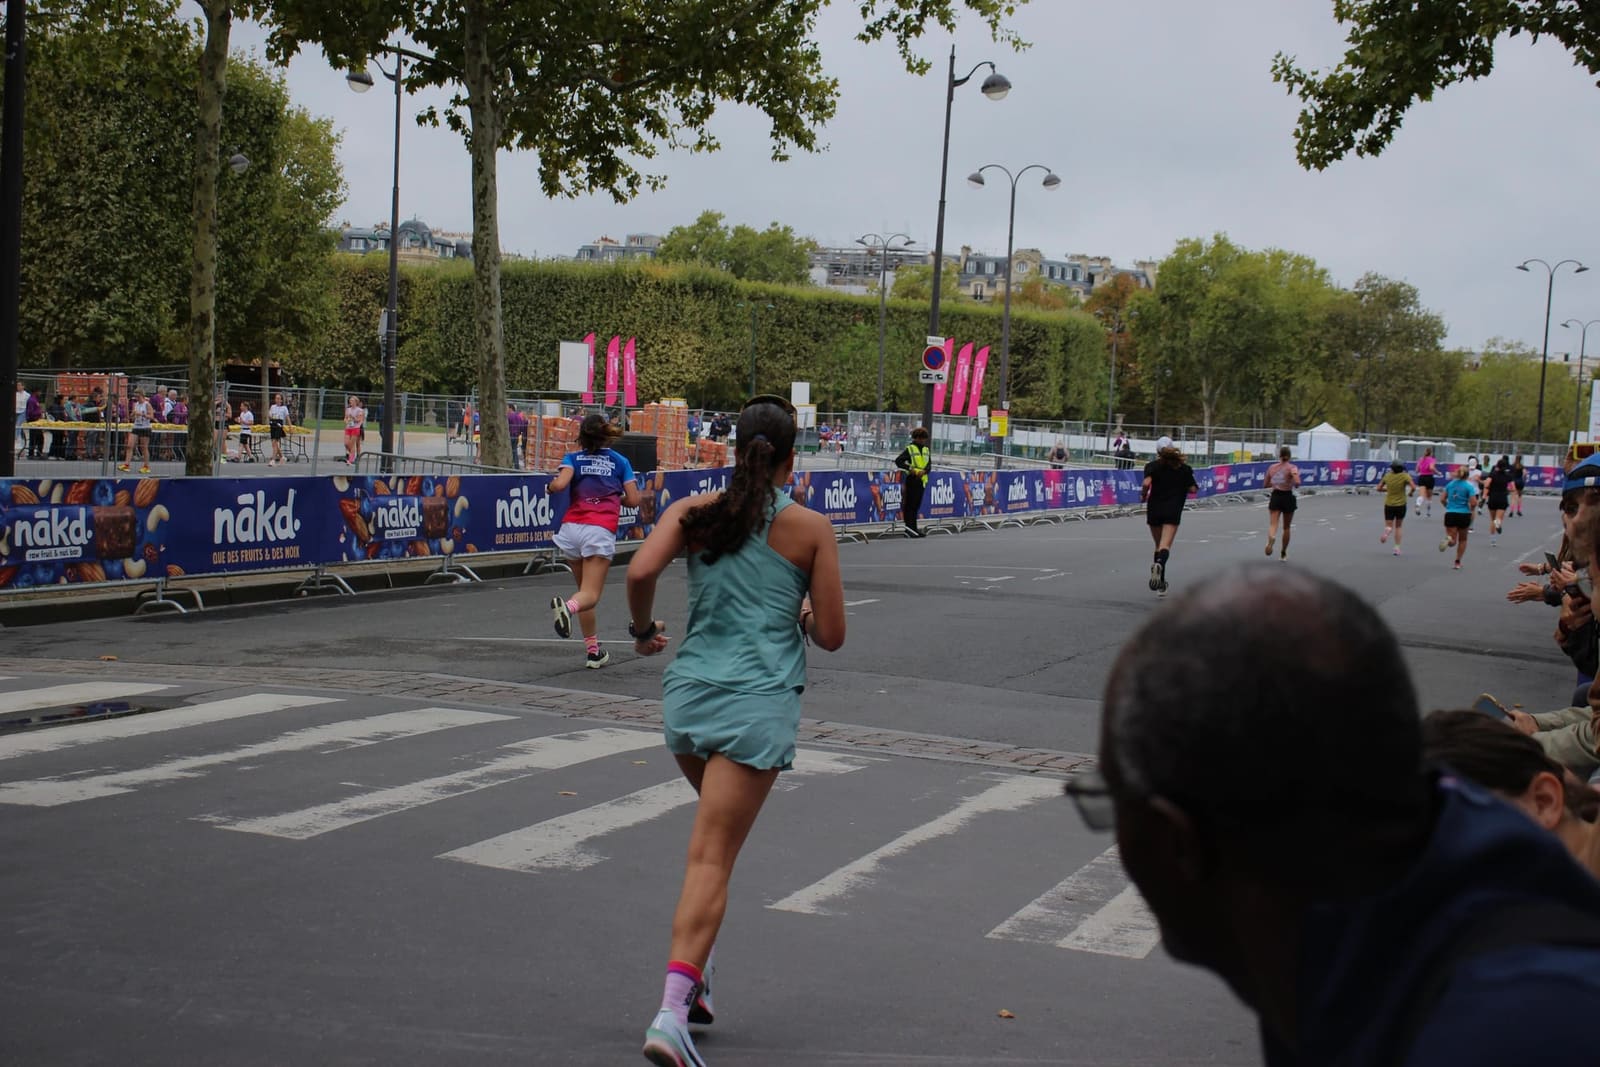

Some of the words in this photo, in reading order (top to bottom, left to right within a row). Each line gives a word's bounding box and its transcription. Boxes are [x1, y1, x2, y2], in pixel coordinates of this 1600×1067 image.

[582, 467, 611, 475] Energy
[212, 551, 226, 564] QUE
[227, 550, 239, 563] DES
[240, 548, 263, 562] FRUITS
[264, 547, 271, 560] &
[271, 546, 283, 559] DES
[285, 545, 300, 558] NOIX
